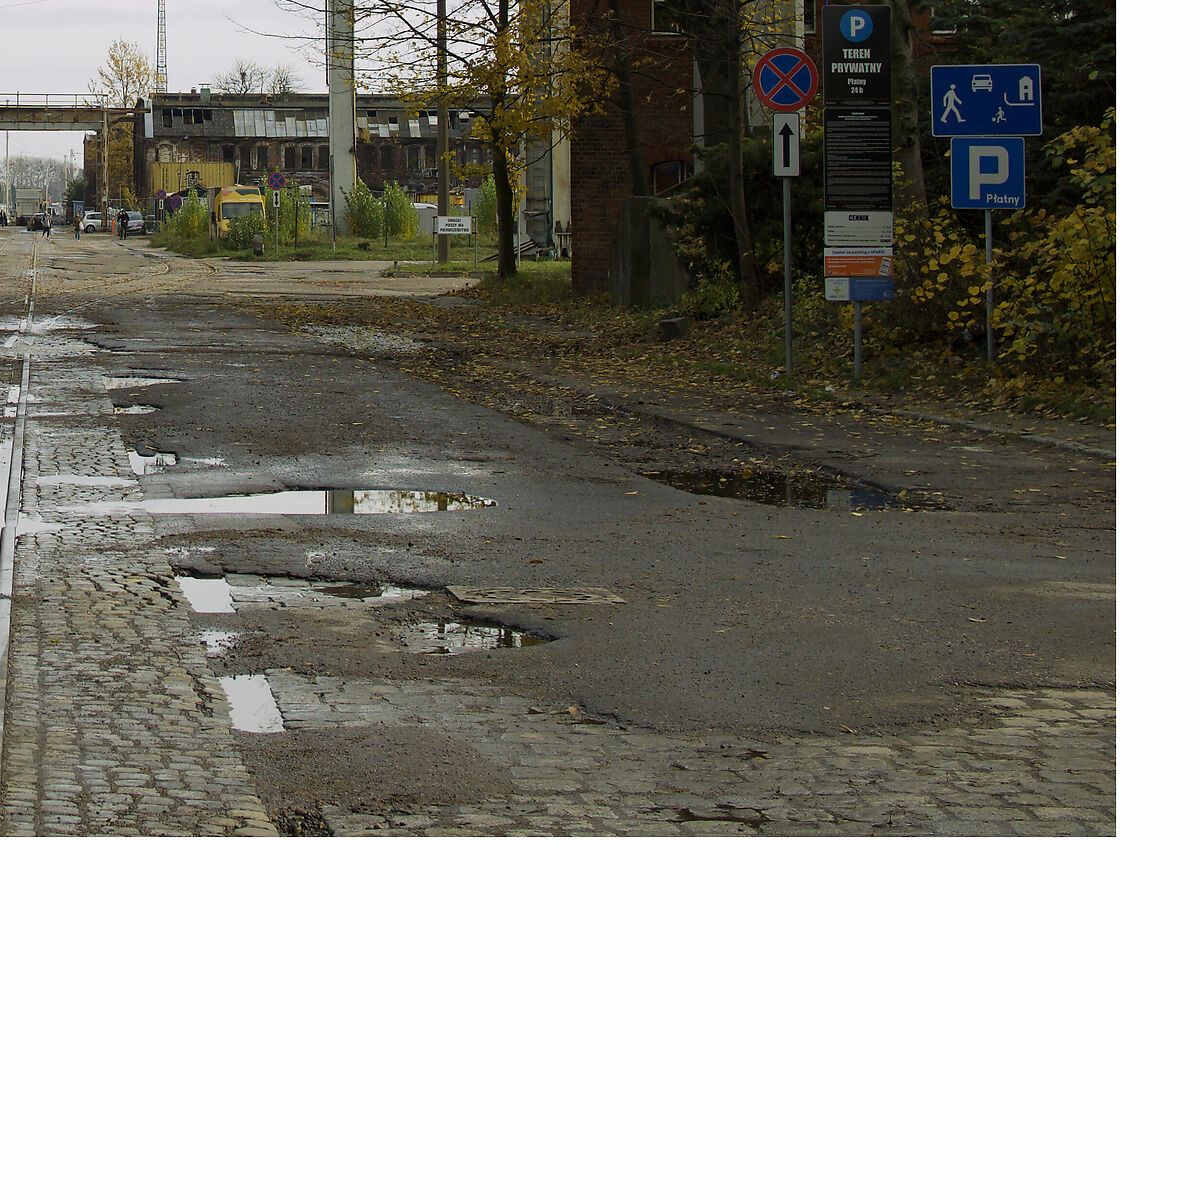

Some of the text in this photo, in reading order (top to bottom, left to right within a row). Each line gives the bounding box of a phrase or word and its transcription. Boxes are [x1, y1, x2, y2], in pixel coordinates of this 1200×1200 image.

[850, 16, 865, 37] P
[842, 48, 870, 59] TEREN
[831, 62, 882, 73] PRYWATNY
[850, 86, 859, 94] 24
[969, 146, 1009, 200] P
[986, 194, 1020, 206] Płatny
